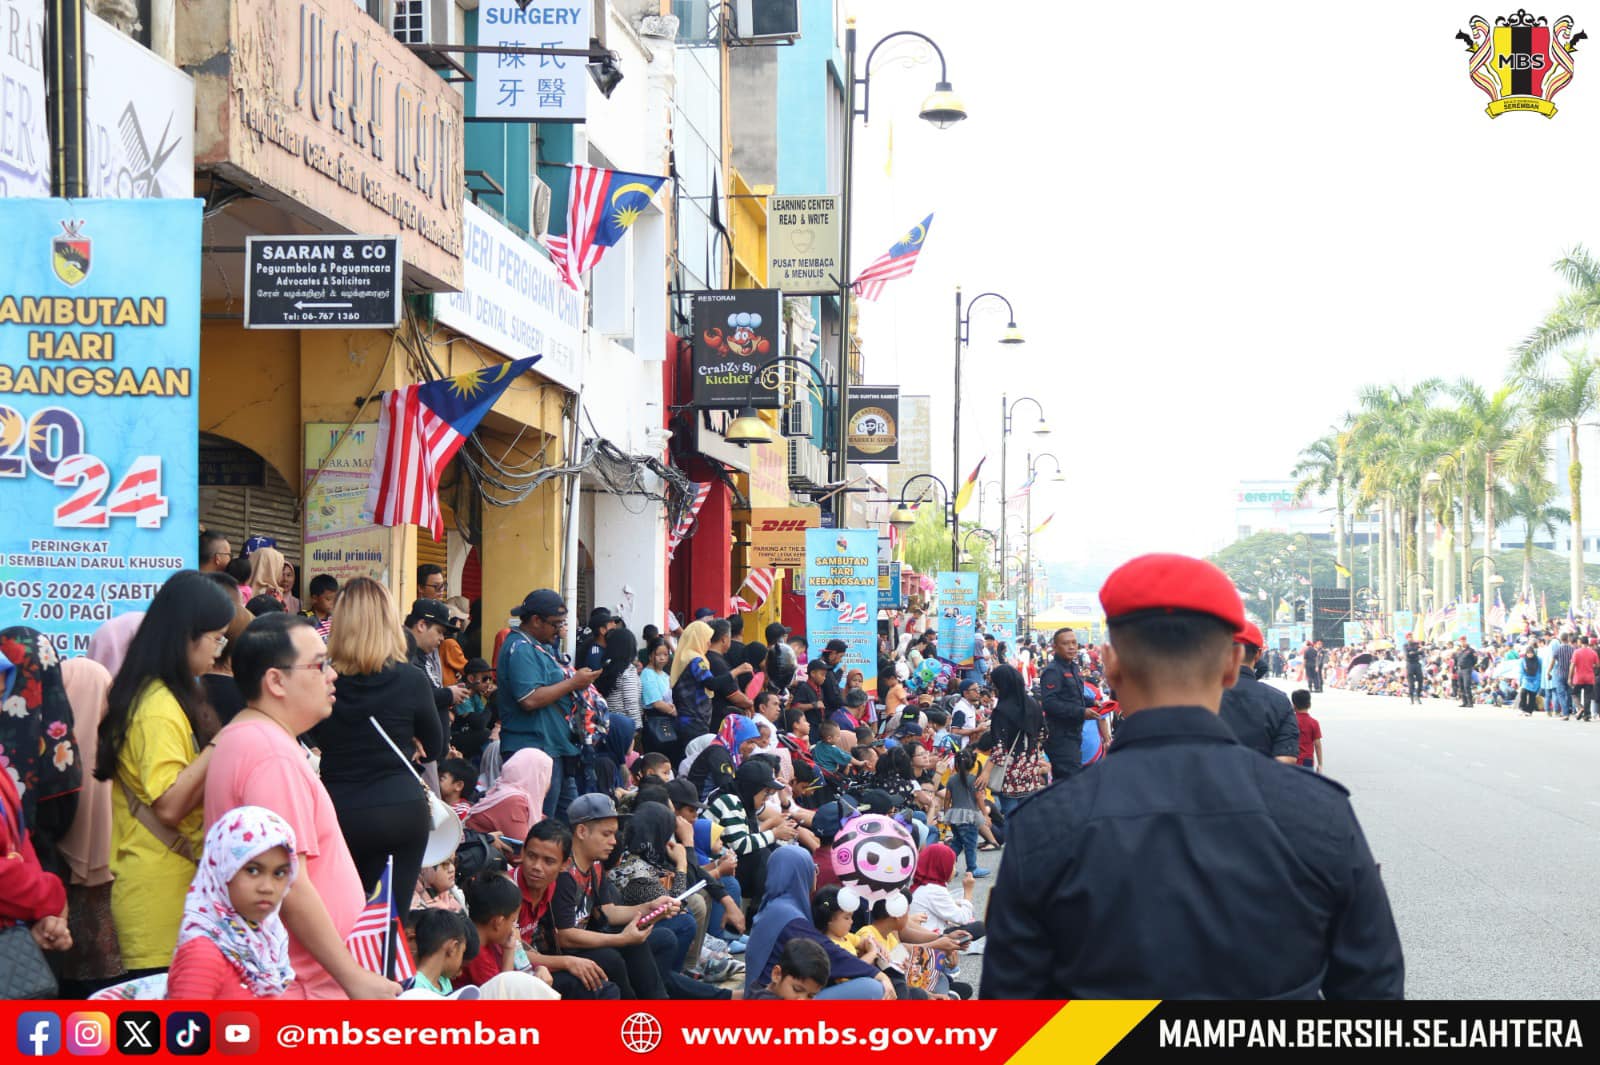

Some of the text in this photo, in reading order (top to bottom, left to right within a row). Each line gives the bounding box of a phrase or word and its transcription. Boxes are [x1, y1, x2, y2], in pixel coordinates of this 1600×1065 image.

[486, 8, 581, 24] SURGERY
[496, 78, 566, 108] 牙醫
[773, 199, 835, 211] LEARNING CENTER
[779, 213, 829, 225] READ & WRITE
[263, 245, 386, 260] SAARAN & CO
[256, 263, 391, 275] Peguambela & Peguamcara
[773, 258, 835, 268] PUSAT MEMBACA
[784, 269, 824, 279] & MENULIS
[276, 276, 370, 286] Advocates & Solicitors
[498, 242, 556, 316] PERGIGIAN
[558, 286, 581, 331] CHIN
[0, 295, 166, 327] AMBUTAN
[283, 312, 360, 321] Tel: 06-767 1360
[476, 294, 508, 336] DENTAL
[511, 314, 545, 353] SURGERY
[28, 330, 115, 361] HARI
[0, 364, 191, 397] BANGSAAN
[761, 519, 807, 531] DHL
[31, 540, 109, 553] PERINGKAT
[9, 555, 77, 568] SEMBILAN
[81, 557, 125, 569] DARUL
[129, 557, 183, 569] KHUSUS
[313, 548, 382, 563] digital printing
[815, 556, 869, 567] SAMBUTAN
[829, 566, 854, 577] HARI
[809, 577, 875, 587] KEBANGSAAN
[47, 583, 96, 600] 2024
[21, 603, 112, 620] 7.00 PAGI
